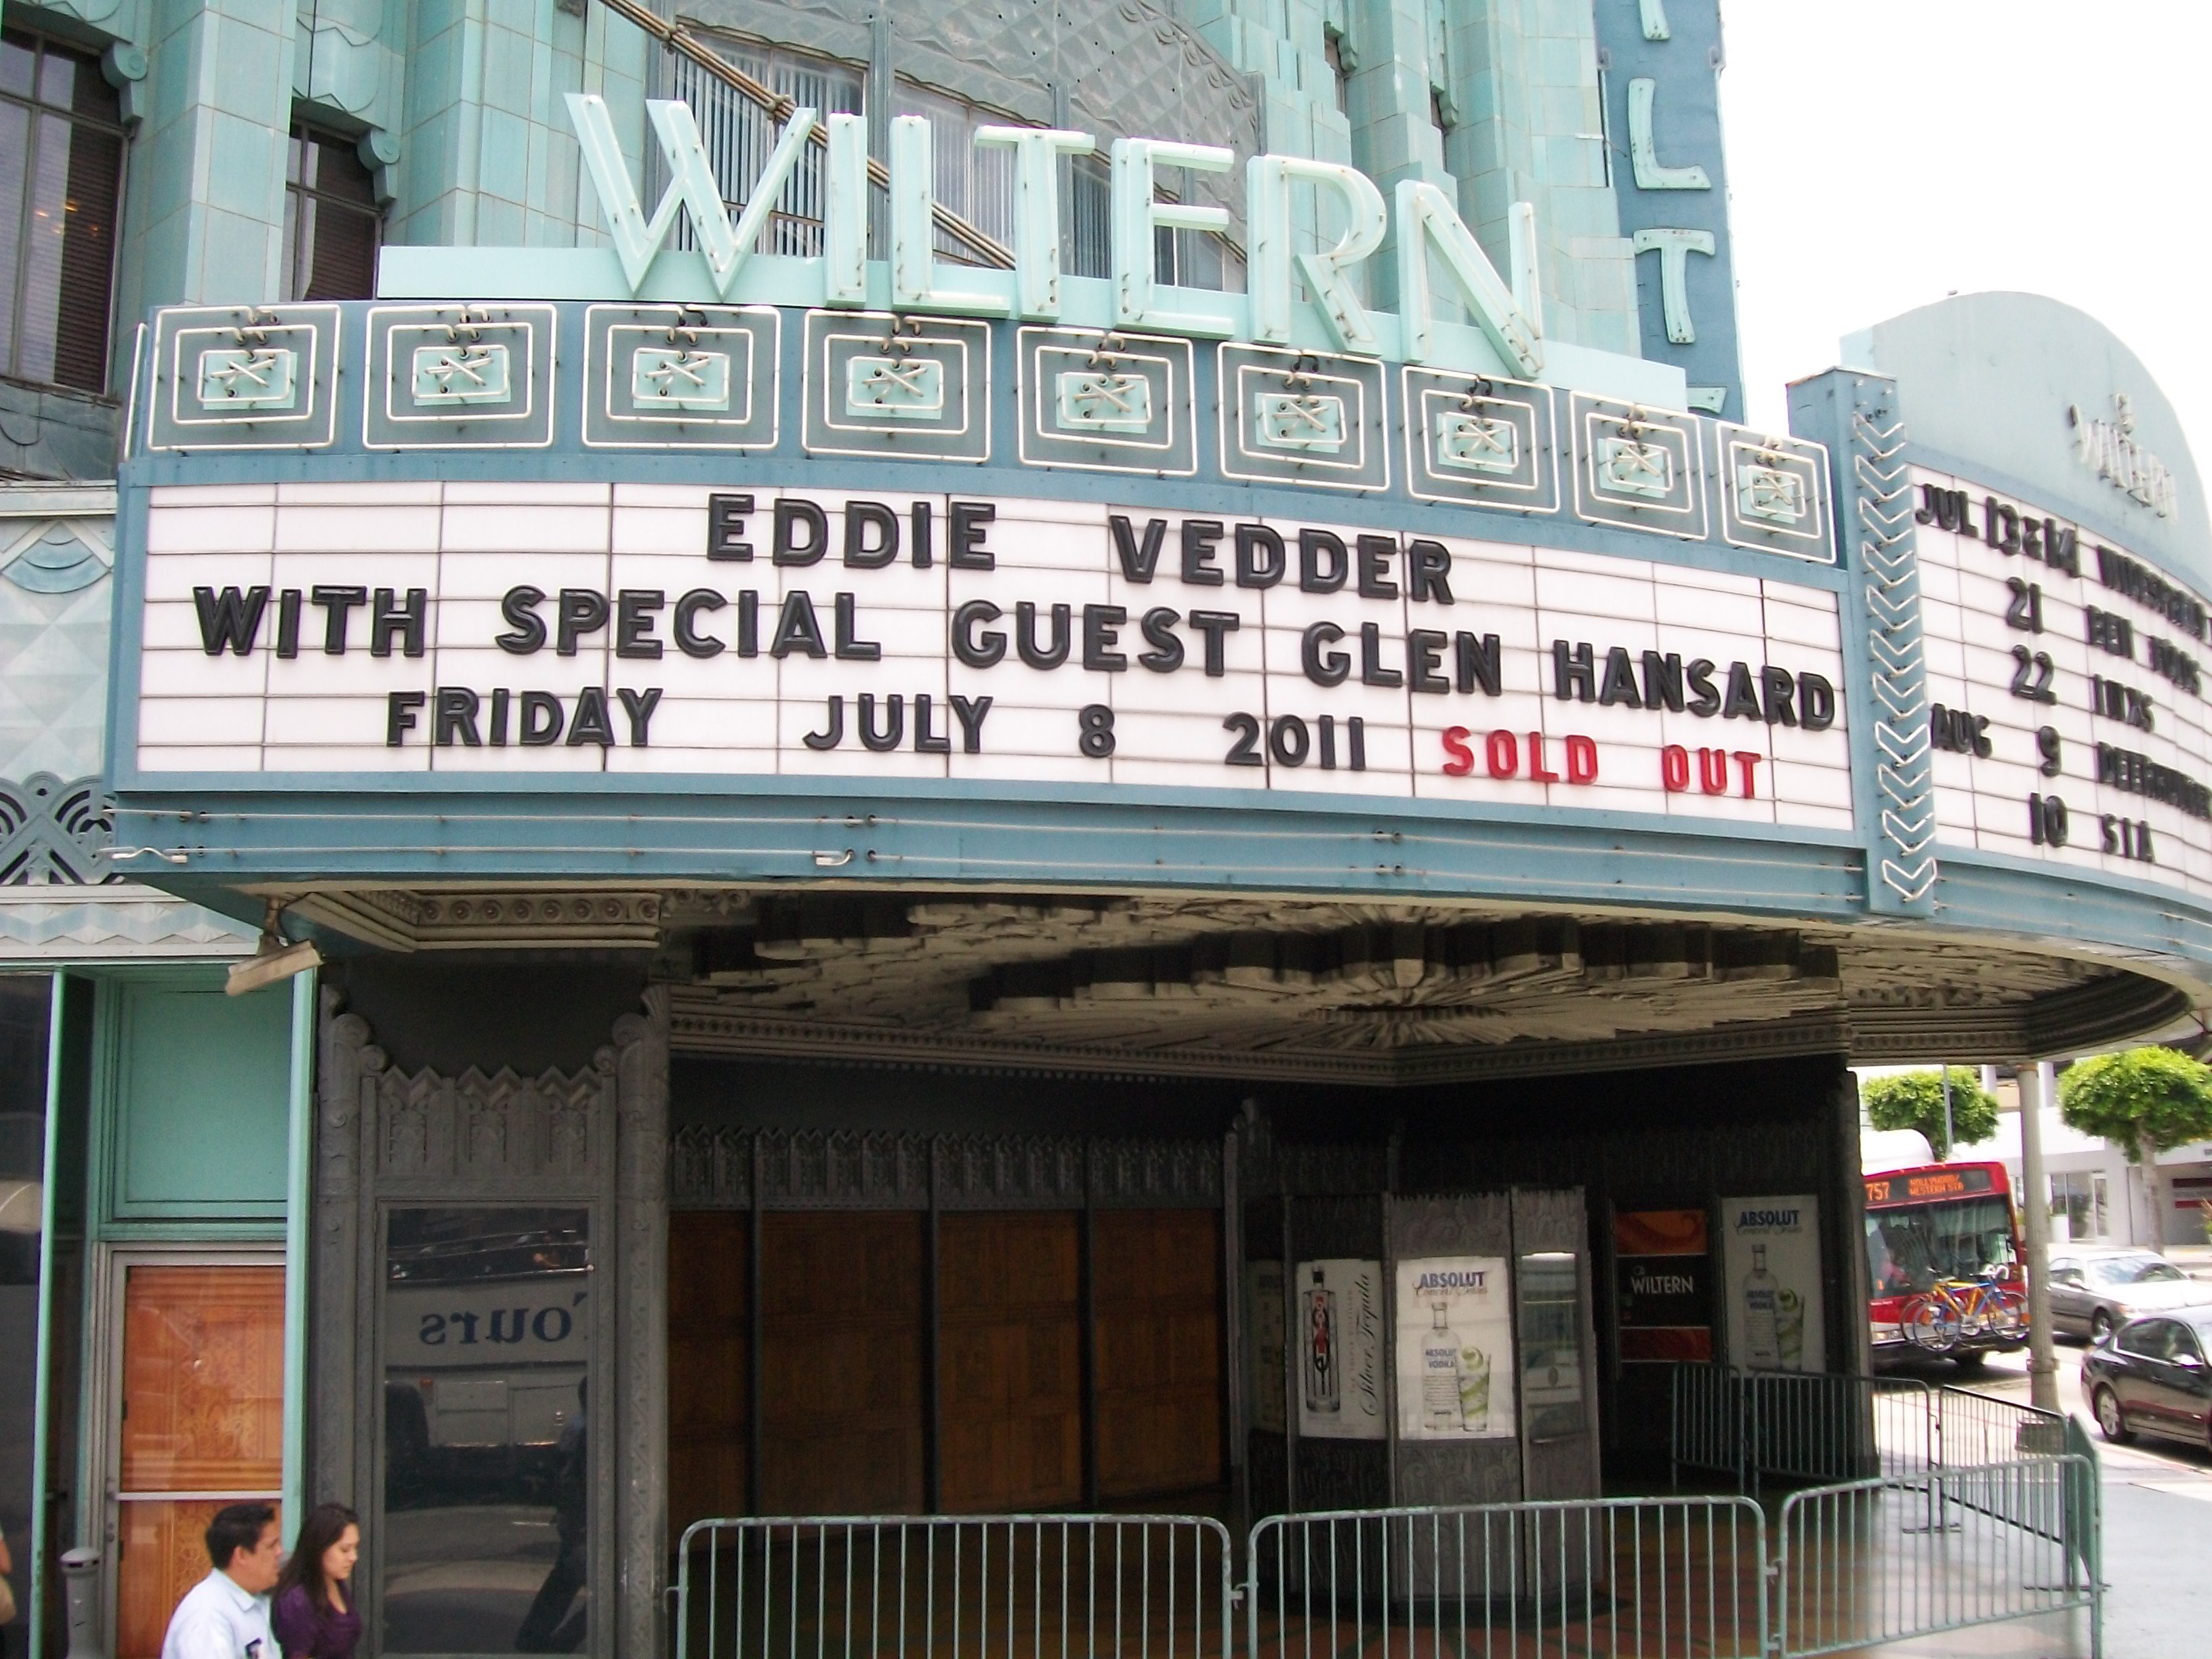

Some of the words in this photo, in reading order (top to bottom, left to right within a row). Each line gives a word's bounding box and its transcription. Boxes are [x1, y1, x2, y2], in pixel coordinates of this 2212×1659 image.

[564, 93, 1544, 378] WILTERN
[1915, 483, 1979, 538] JUL
[708, 493, 996, 571] EDDIE
[1110, 514, 1455, 605] VEDDER
[2007, 577, 2044, 634] 21
[193, 585, 427, 659] WITH
[495, 586, 881, 661] SPECIAL
[951, 600, 1240, 677] GUEST
[1302, 621, 1502, 698] GLEN
[1551, 640, 1835, 731] HANSARD
[2011, 644, 2057, 705] 22
[386, 686, 663, 747] FRIDAY
[803, 693, 994, 754] JULY
[1079, 703, 1116, 758] 8
[1223, 712, 1366, 771] 2011
[1441, 725, 1600, 786] SOLD
[1660, 743, 1763, 800] OUT
[1931, 703, 1992, 758] AUG
[2038, 725, 2062, 777] 9
[2030, 792, 2068, 848] 10
[2102, 813, 2156, 863] SIA
[1740, 1210, 1799, 1225] ABSOLUT
[1865, 1181, 1889, 1202] 757
[1420, 1271, 1486, 1288] ABSOLUT
[1631, 1276, 1693, 1294] WILTERN
